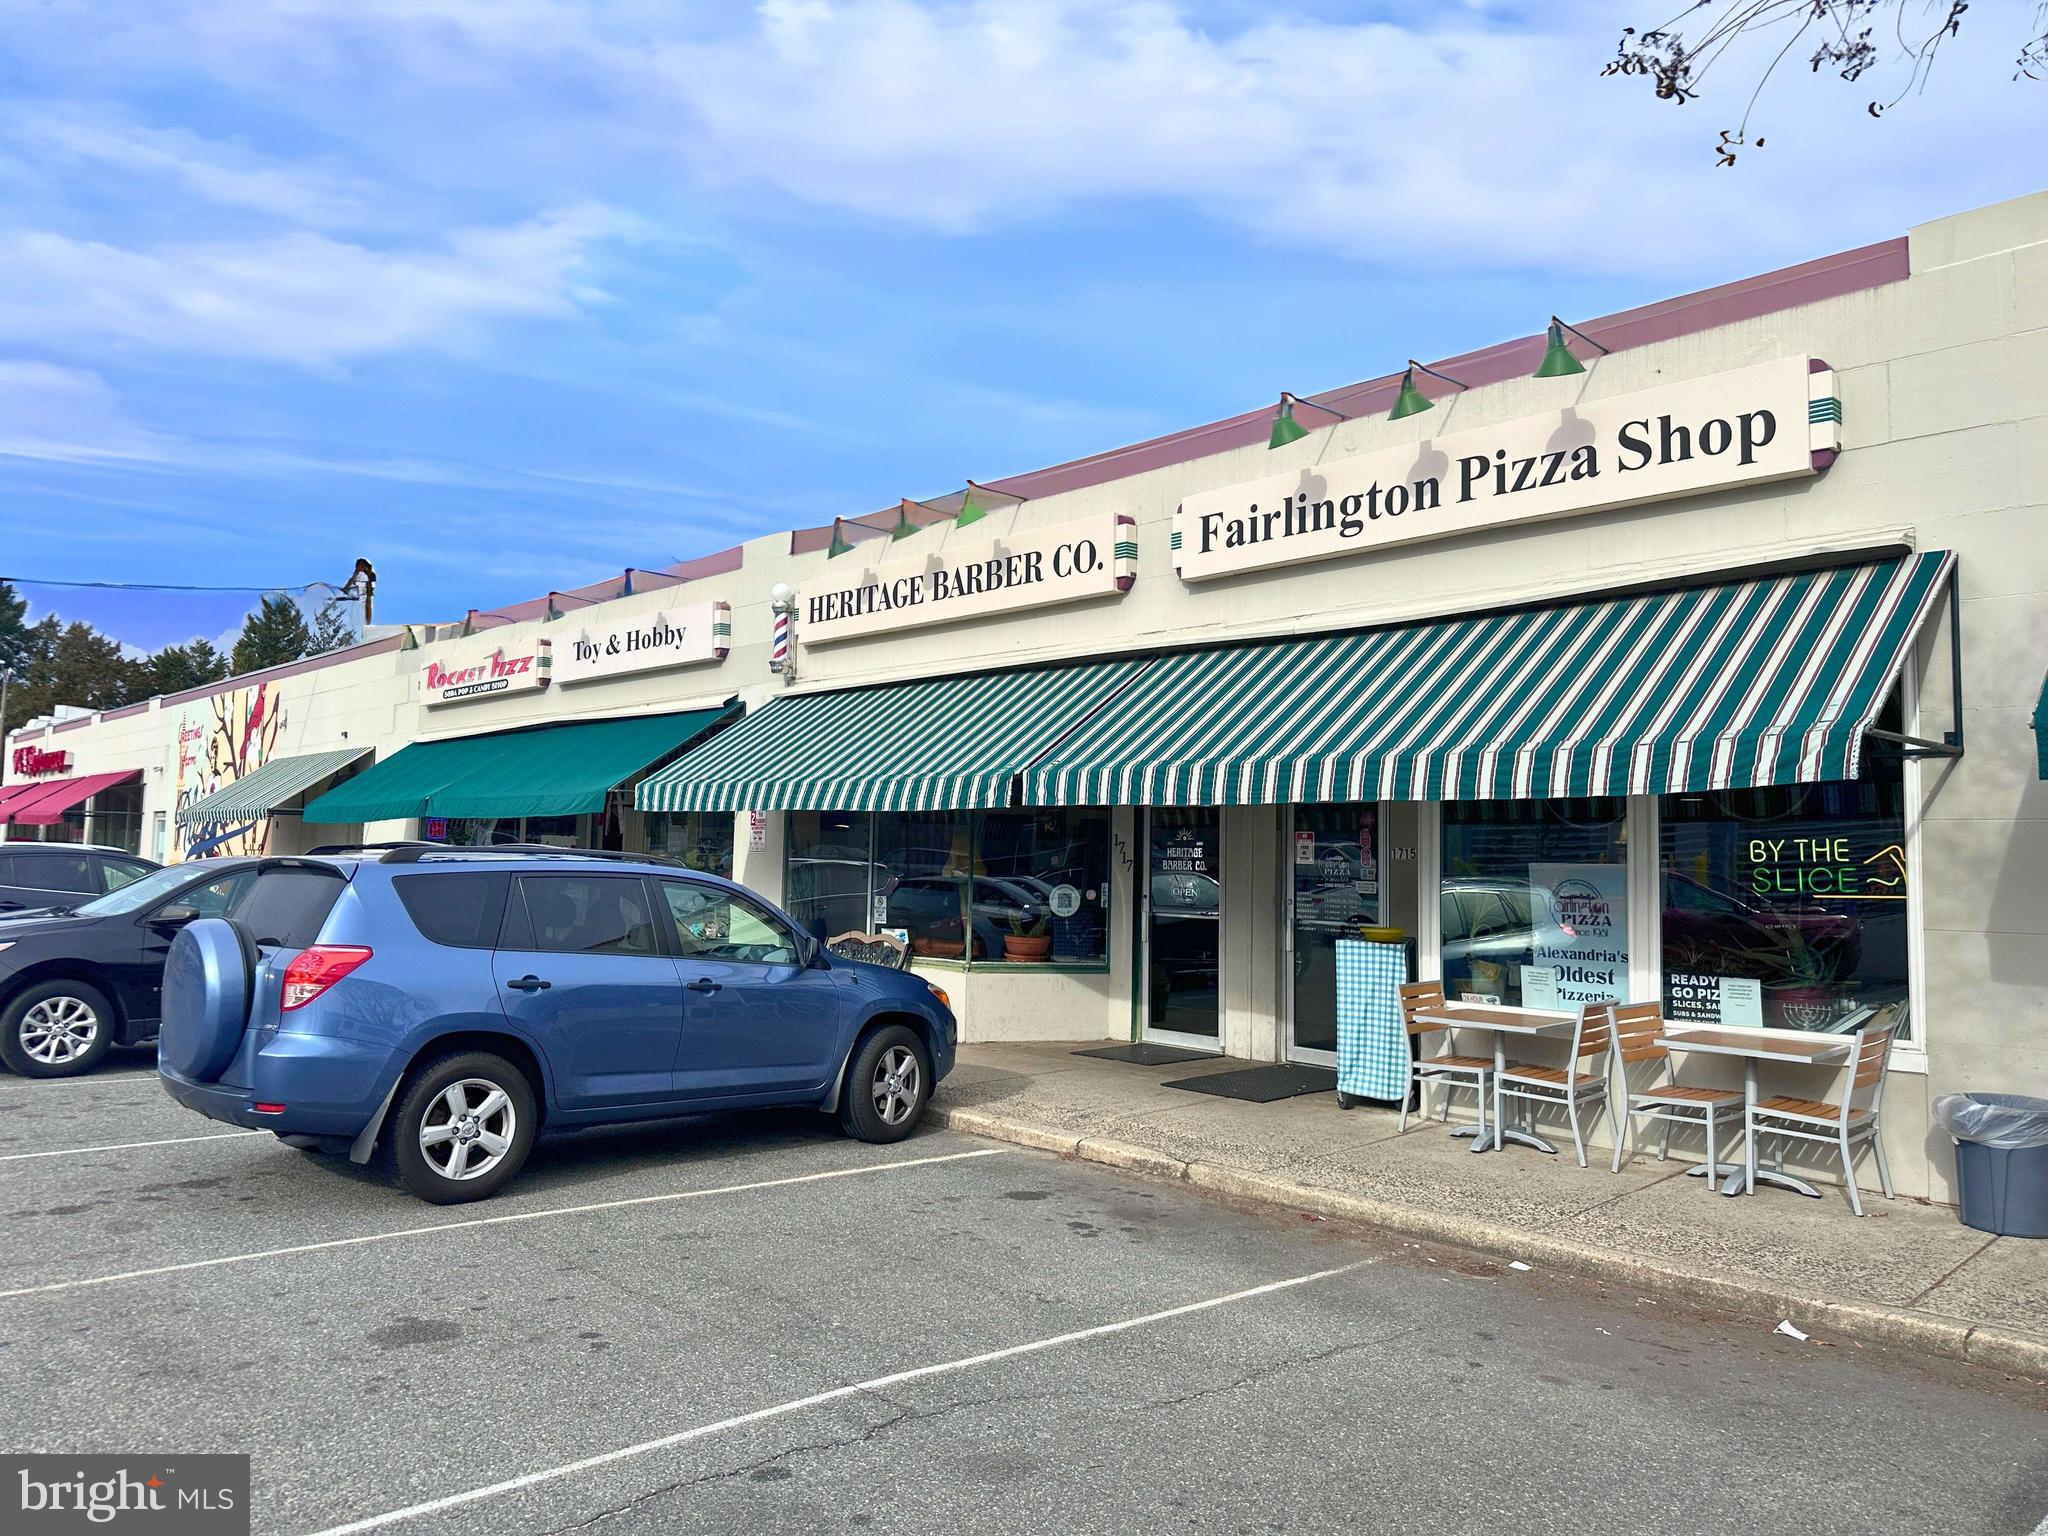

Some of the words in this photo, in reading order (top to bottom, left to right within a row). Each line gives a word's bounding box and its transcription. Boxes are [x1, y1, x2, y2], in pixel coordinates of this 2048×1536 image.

[1198, 476, 1442, 554] Fairlington
[1455, 442, 1601, 504] Pizza
[1616, 407, 1778, 473] Shop
[808, 575, 925, 625] HERITAGE
[932, 550, 1044, 602] BARBER
[1052, 539, 1104, 579] CO.
[573, 641, 602, 664] Toy
[606, 634, 621, 655] &
[626, 624, 687, 652] Hobby
[457, 687, 469, 696] POP
[473, 683, 491, 693] CANDY
[491, 680, 508, 690] SHOP
[1113, 834, 1133, 872] 1717
[1167, 847, 1203, 858] HERITAGE
[1392, 847, 1416, 860] 1715
[1750, 838, 1785, 863] BY
[1793, 837, 1850, 863] THE
[1162, 860, 1193, 871] BARBER
[1195, 860, 1208, 871] CO.
[1324, 868, 1351, 876] PIZZA
[1752, 867, 1859, 893] SLICE
[1172, 887, 1198, 897] OPEN
[1561, 913, 1612, 927] PIZZA
[1537, 946, 1628, 963] Alexandria's
[1552, 964, 1615, 985] Oldest
[1671, 973, 1718, 987] READY
[1671, 986, 1694, 998] GO
[1672, 999, 1704, 1010] SLICES,
